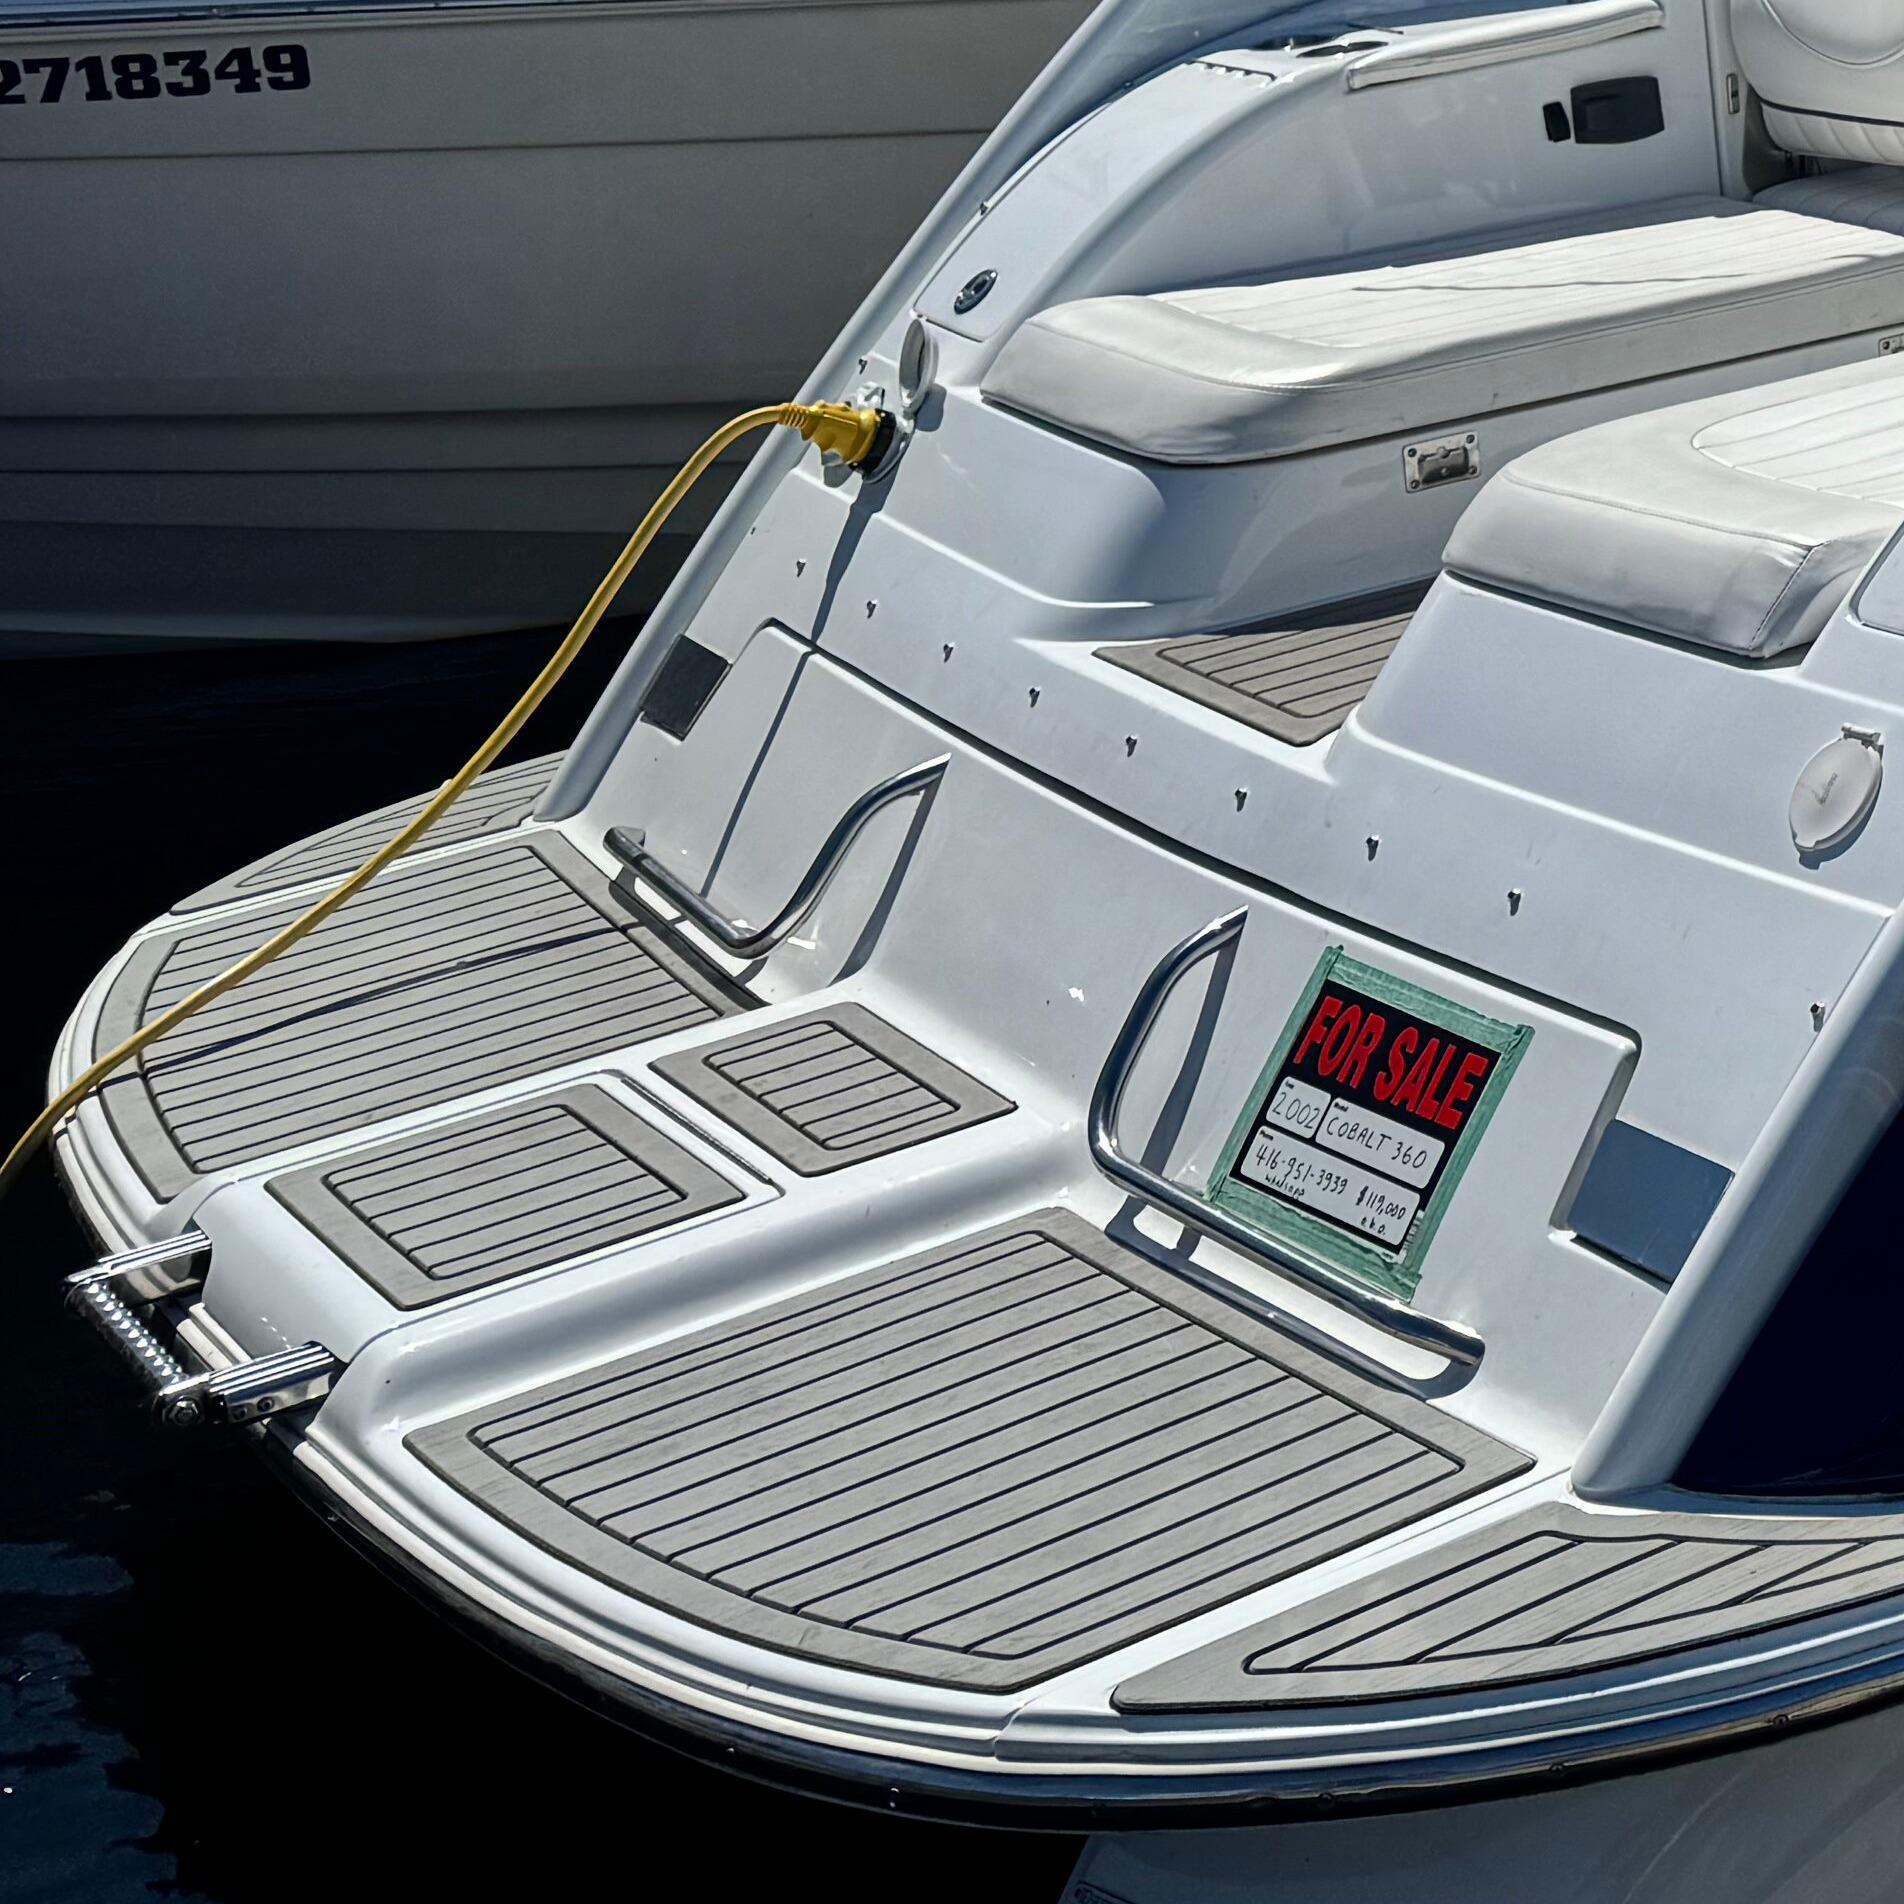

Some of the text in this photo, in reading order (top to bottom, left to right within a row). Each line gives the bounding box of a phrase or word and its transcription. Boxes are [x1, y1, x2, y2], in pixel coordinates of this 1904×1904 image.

[1293, 996, 1489, 1130] FOR SALE
[1272, 1092, 1320, 1129] 2002
[1326, 1117, 1427, 1169] COBALT 360
